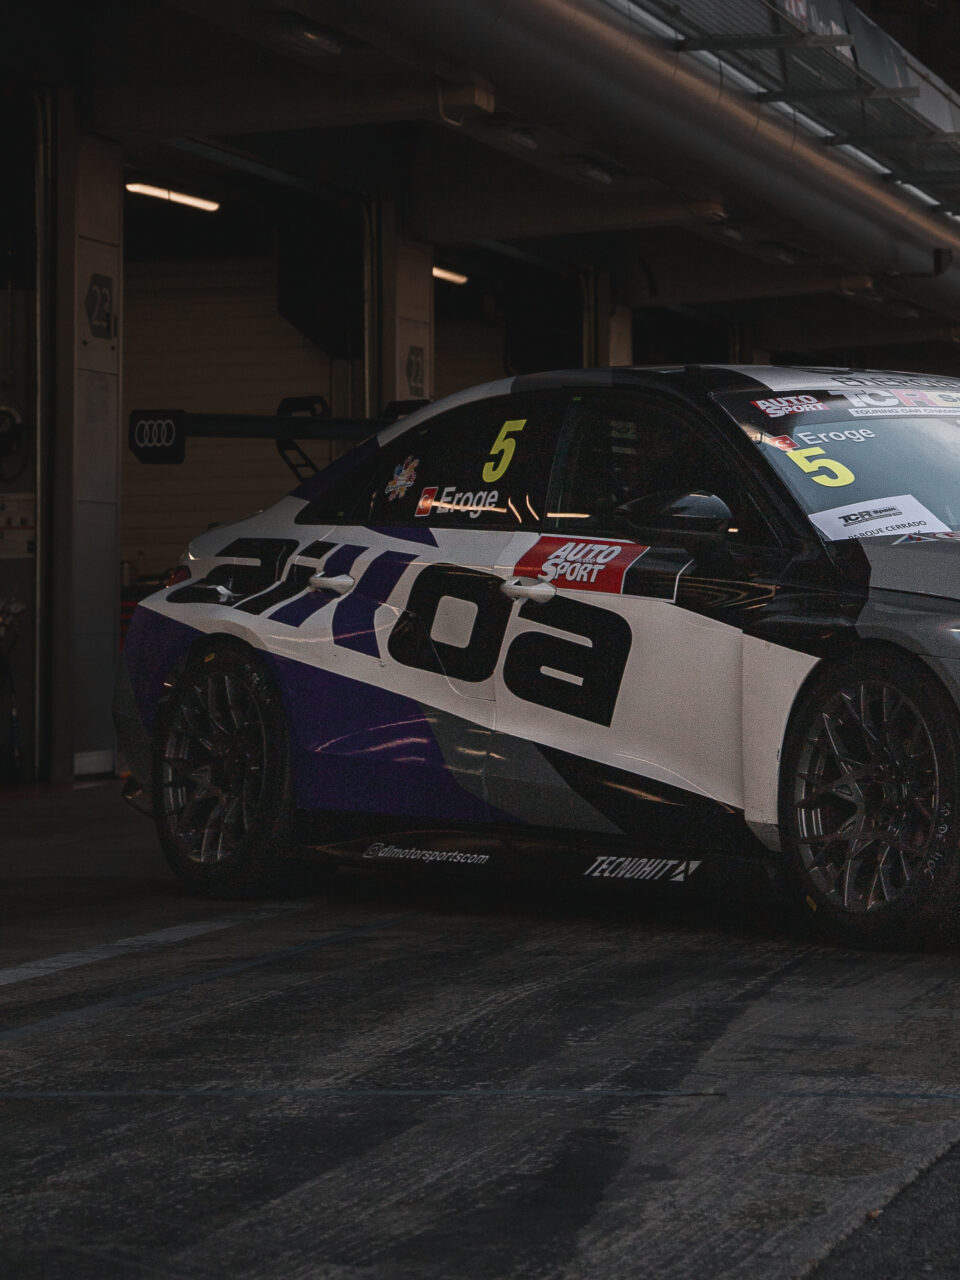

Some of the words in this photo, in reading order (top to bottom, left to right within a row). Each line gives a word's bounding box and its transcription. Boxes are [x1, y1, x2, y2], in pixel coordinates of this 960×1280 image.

[755, 394, 818, 411] AUTO
[826, 388, 940, 408] TCR
[765, 402, 826, 418] SPORT
[855, 408, 897, 416] TOURING
[797, 428, 876, 446] Eroge
[482, 418, 528, 484] 5
[786, 446, 856, 488] 5
[437, 486, 499, 519] Eroge
[838, 510, 873, 524] TCR
[872, 506, 897, 515] Spain
[885, 520, 927, 533] CERRADO
[548, 541, 623, 564] AUTO
[538, 559, 606, 584] SPORT
[583, 855, 681, 881] TECNOHIT
